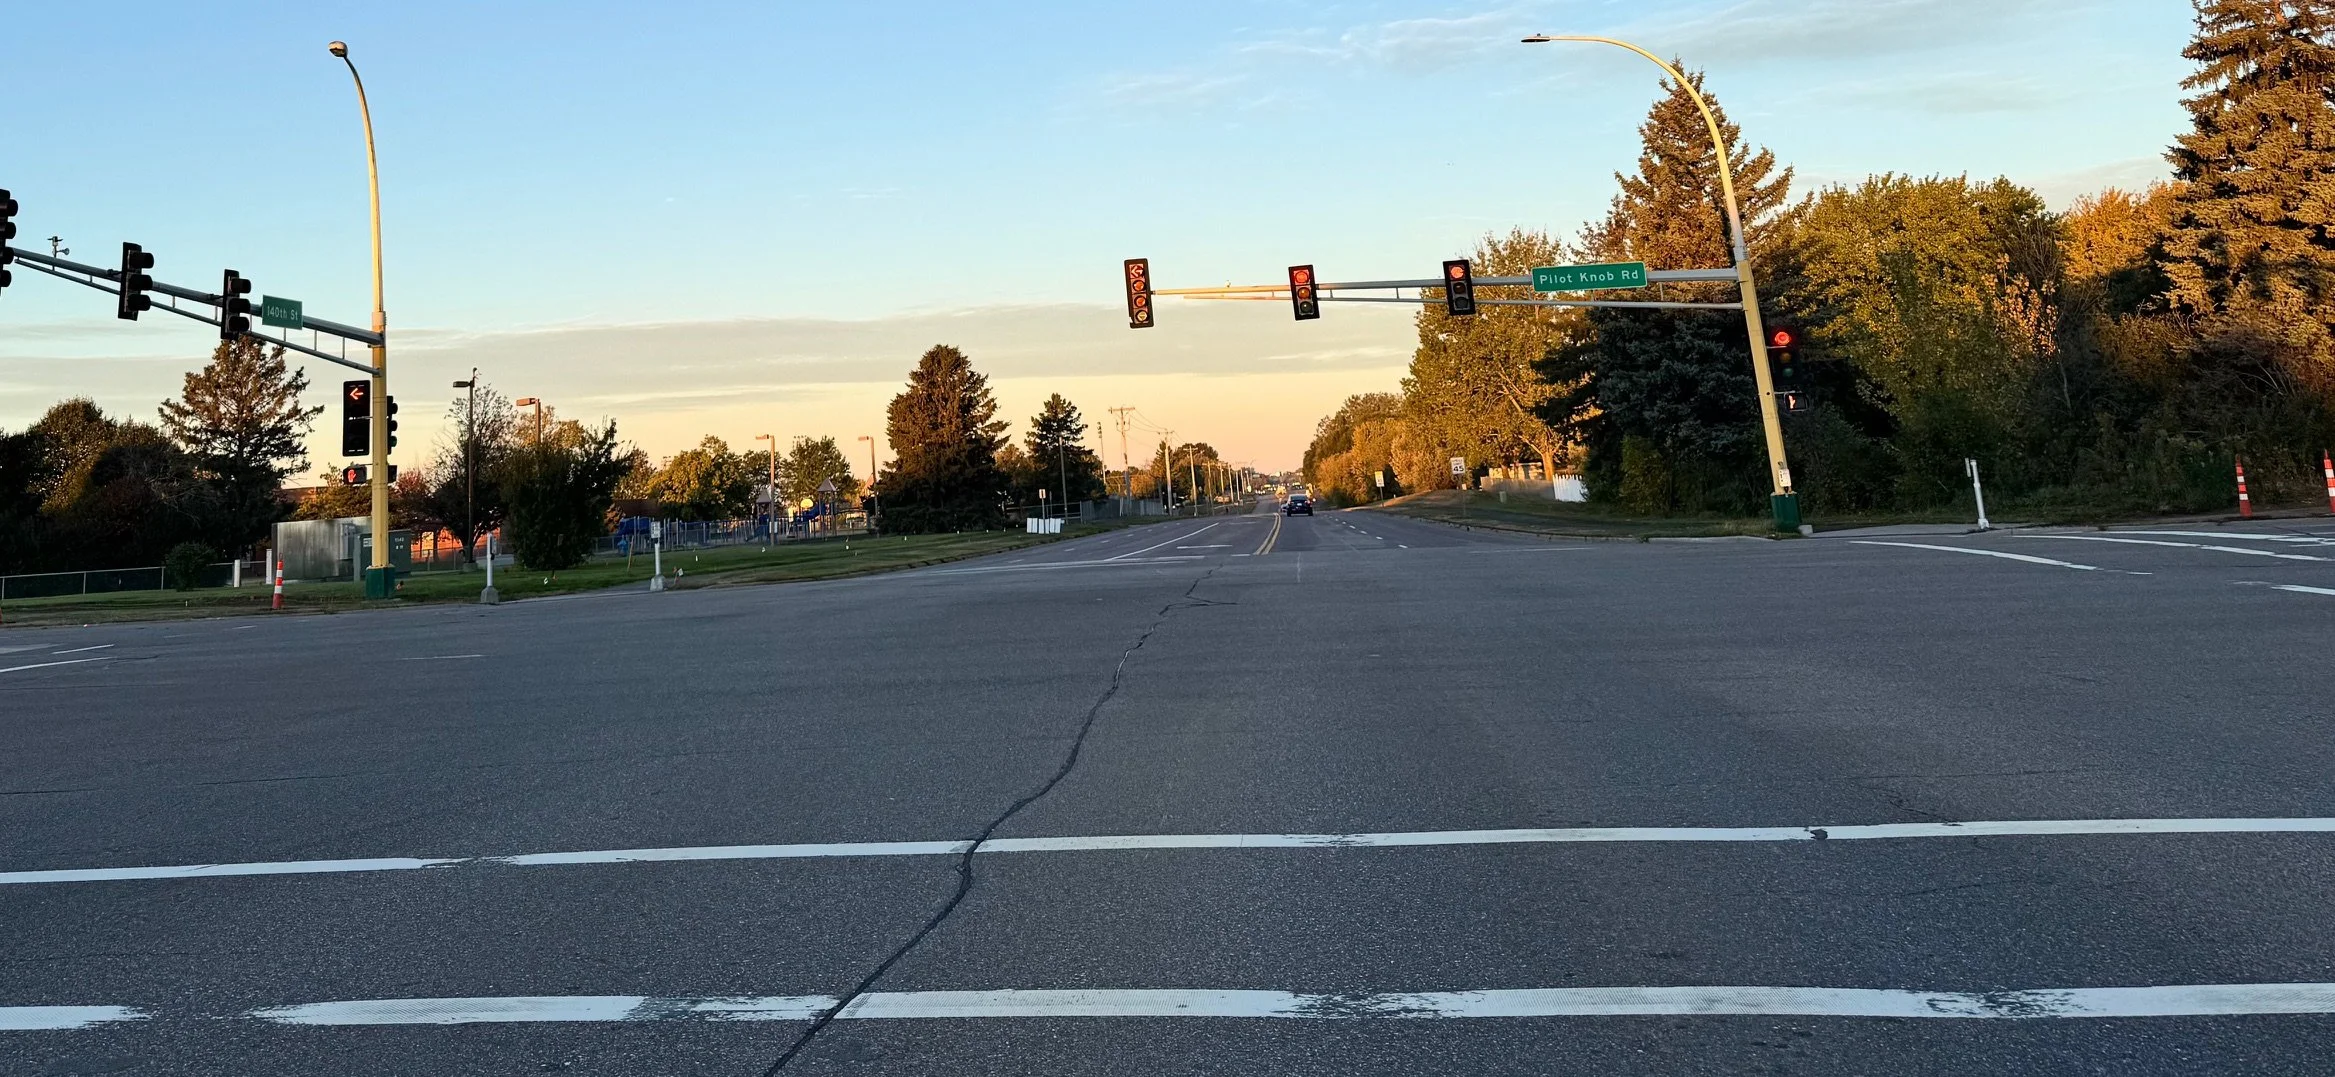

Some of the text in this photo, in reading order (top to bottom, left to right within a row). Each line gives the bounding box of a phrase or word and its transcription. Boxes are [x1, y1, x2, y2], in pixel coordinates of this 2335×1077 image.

[1540, 269, 1639, 284] Pilot Knob Rd
[267, 305, 298, 321] 140th St
